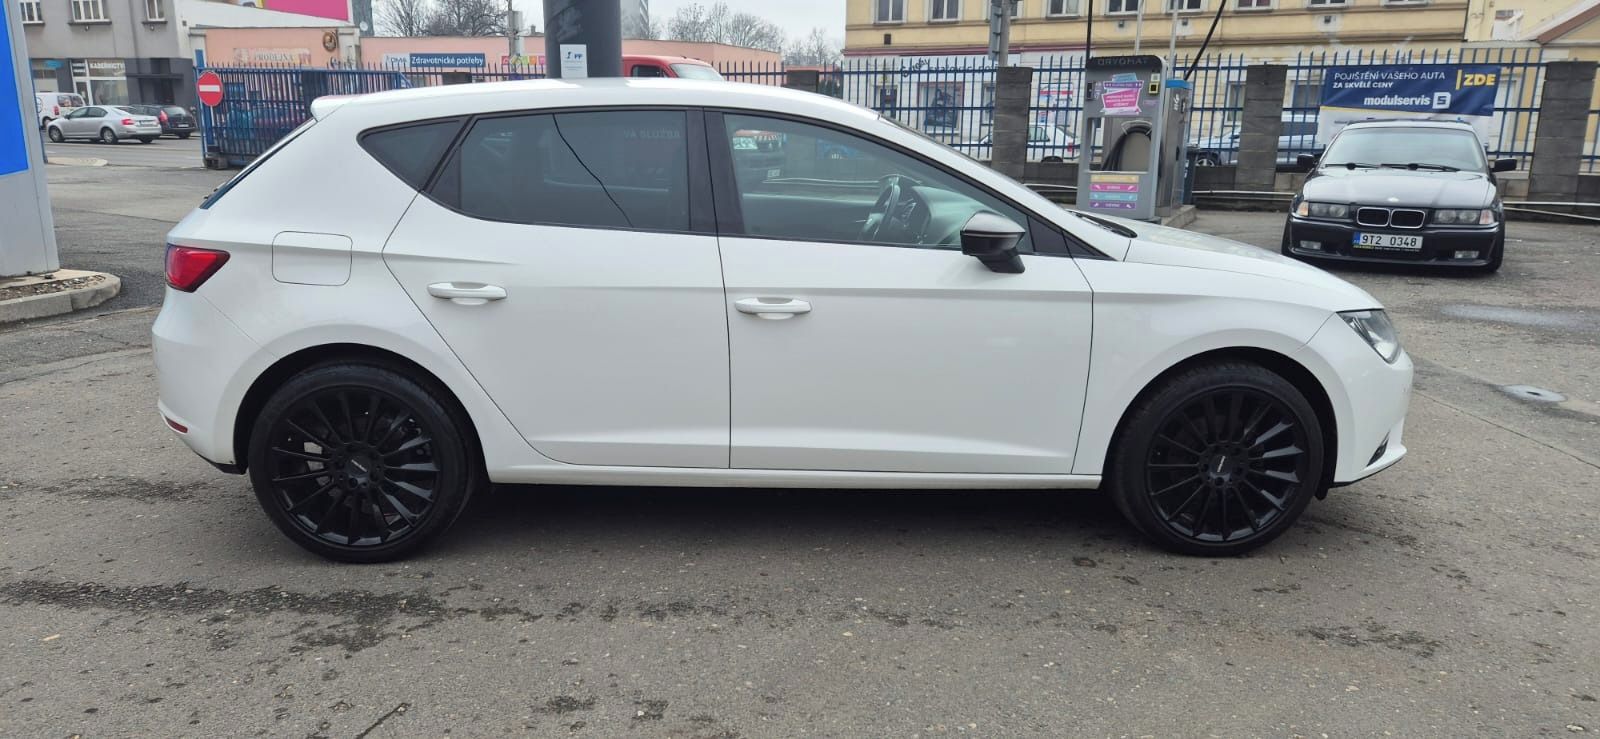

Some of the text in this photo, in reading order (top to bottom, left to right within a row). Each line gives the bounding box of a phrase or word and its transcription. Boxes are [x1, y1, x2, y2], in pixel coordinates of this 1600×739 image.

[411, 56, 455, 64] Zdravotnické
[456, 56, 484, 66] potřeby
[1380, 70, 1420, 80] VAŠEHO
[1420, 71, 1446, 80] AUTA
[1463, 73, 1497, 86] ZDE
[1363, 94, 1431, 106] modulservis
[1362, 234, 1417, 247] 9T2 0348
